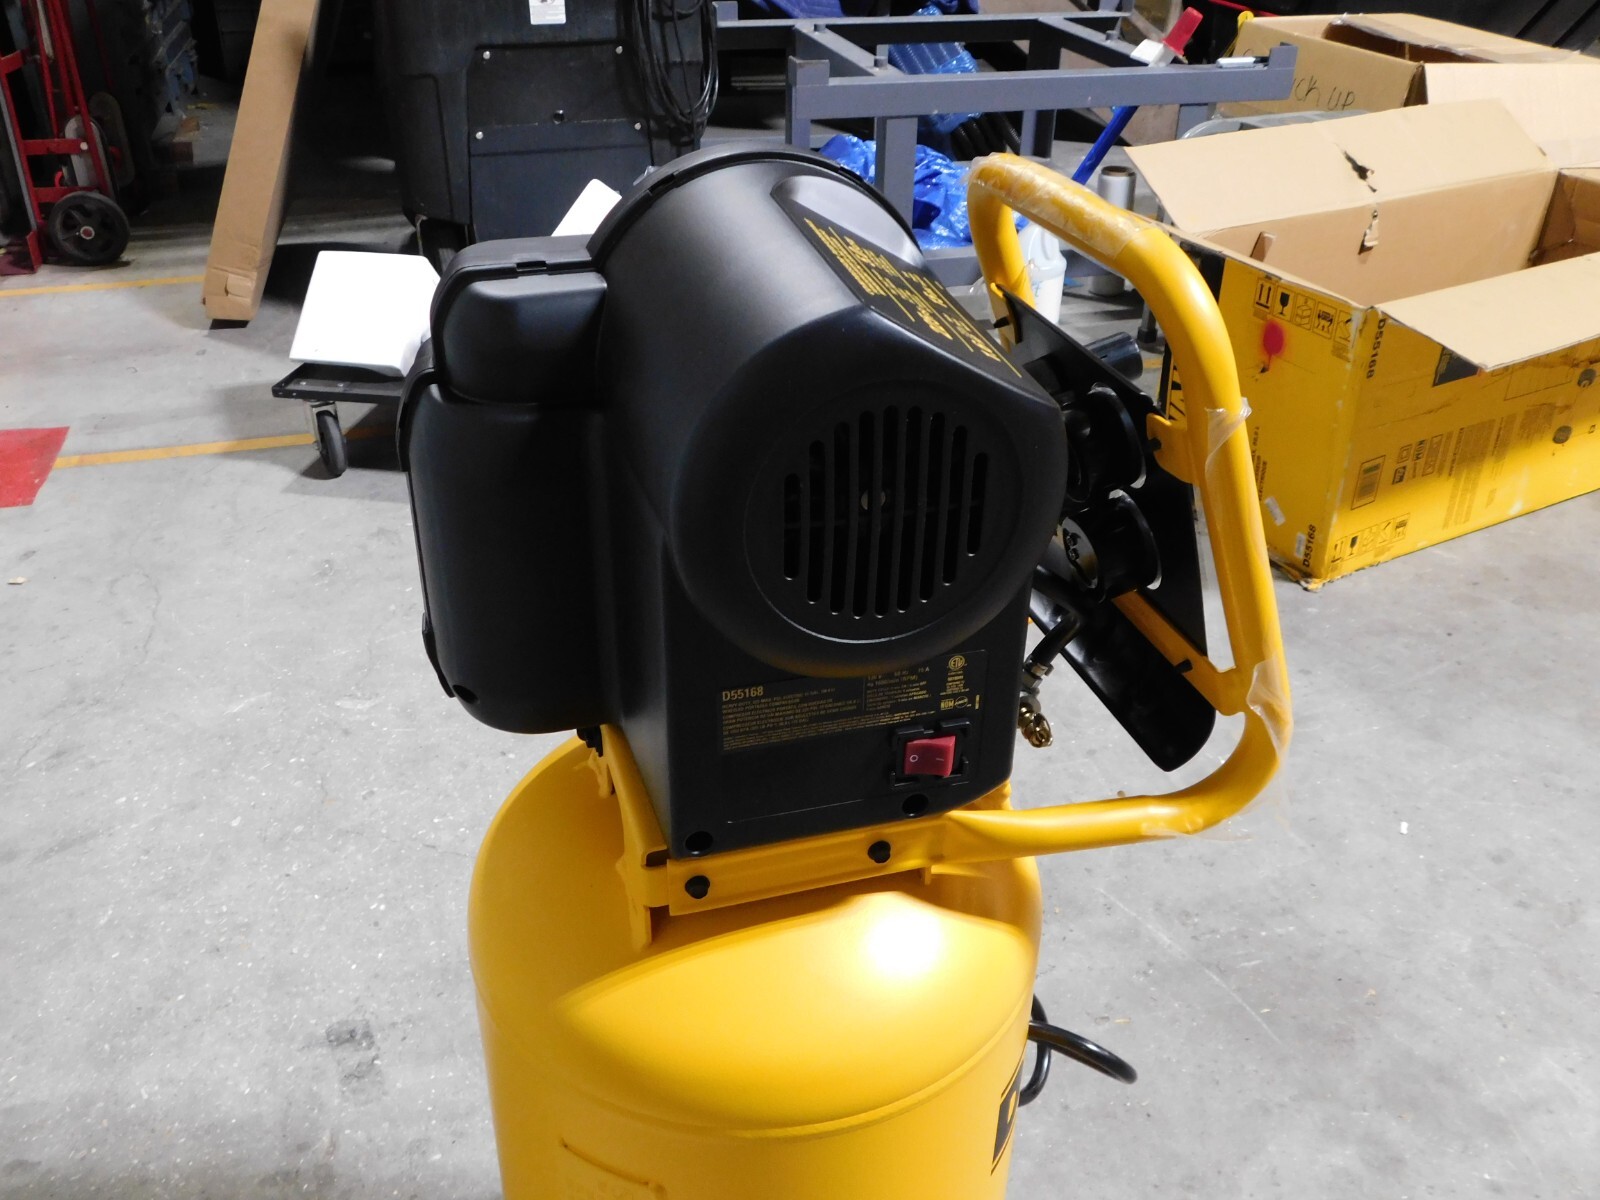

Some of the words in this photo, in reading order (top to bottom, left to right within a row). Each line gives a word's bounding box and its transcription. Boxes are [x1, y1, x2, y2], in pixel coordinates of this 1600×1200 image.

[1367, 318, 1387, 379] D55168
[1303, 524, 1316, 568] D55168
[722, 685, 764, 702] D55168
